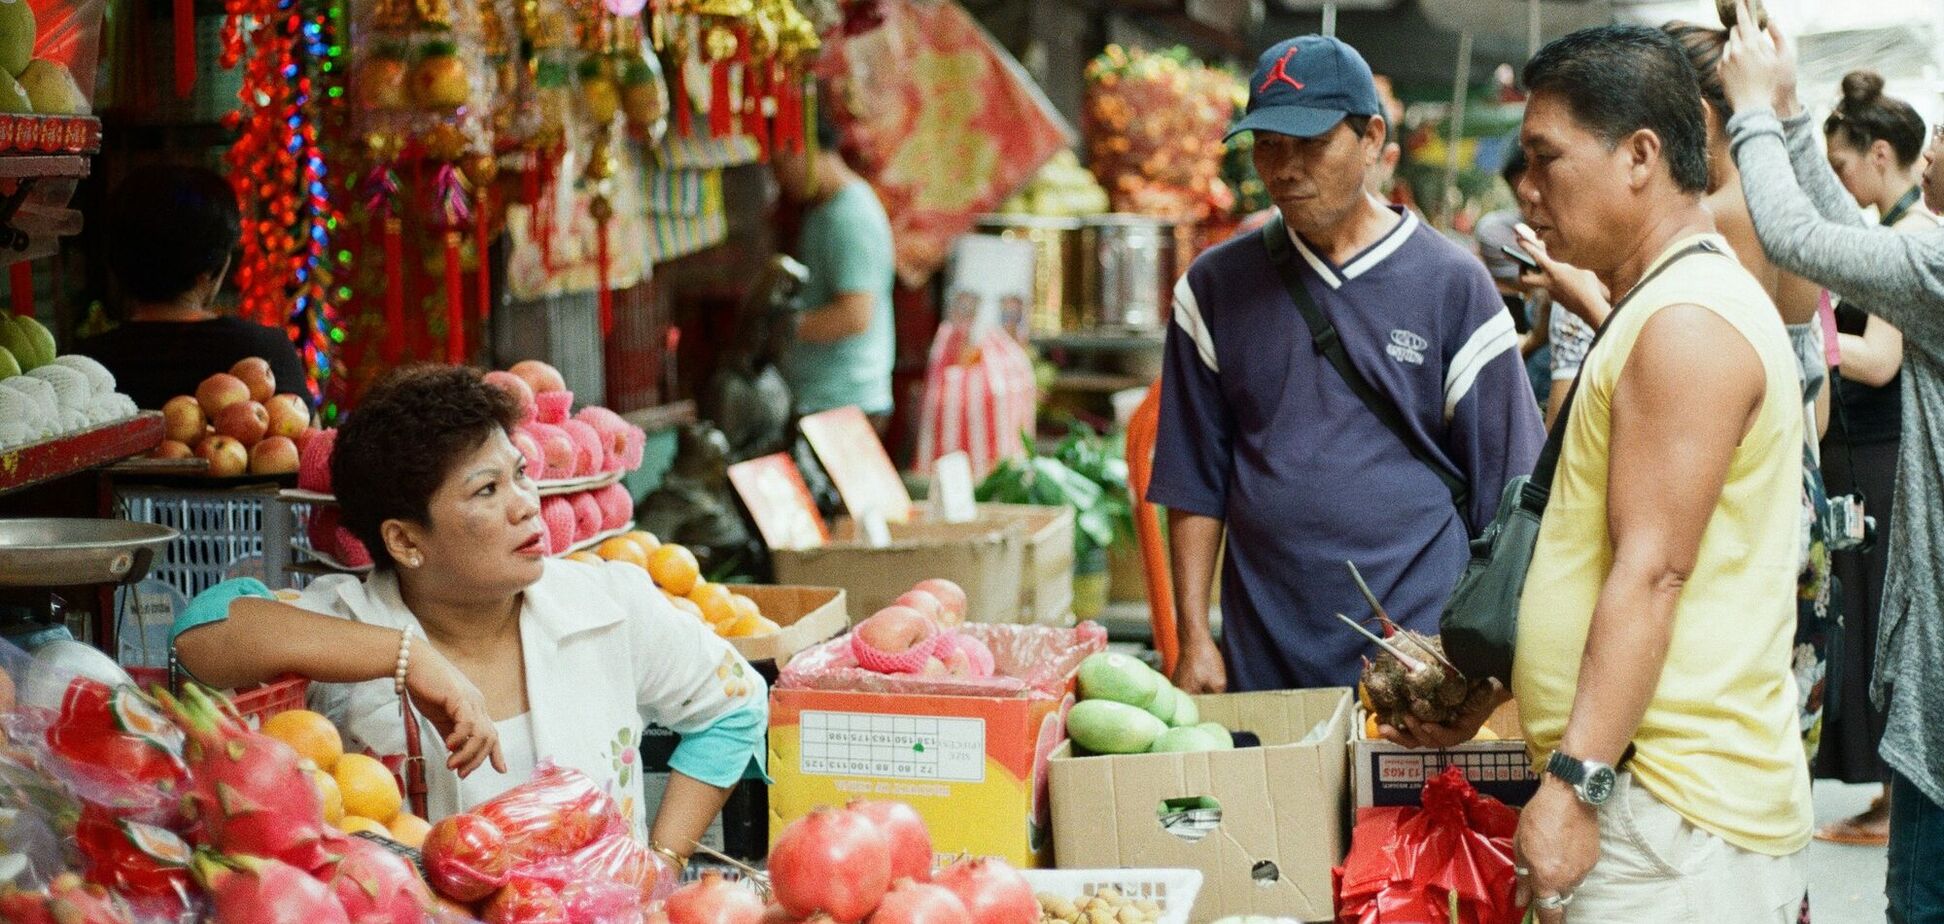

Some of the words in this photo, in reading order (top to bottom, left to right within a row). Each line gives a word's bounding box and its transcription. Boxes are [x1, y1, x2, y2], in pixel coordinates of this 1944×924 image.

[829, 733, 848, 741] 198
[851, 734, 869, 742] 175
[872, 735, 891, 743] 163
[895, 736, 914, 744] 150
[804, 760, 824, 768] 125
[829, 761, 847, 769] 113
[851, 762, 869, 770] 100
[875, 763, 889, 771] 88
[921, 766, 933, 774] 72
[1383, 767, 1406, 778] KGS
[1408, 767, 1420, 778] 13
